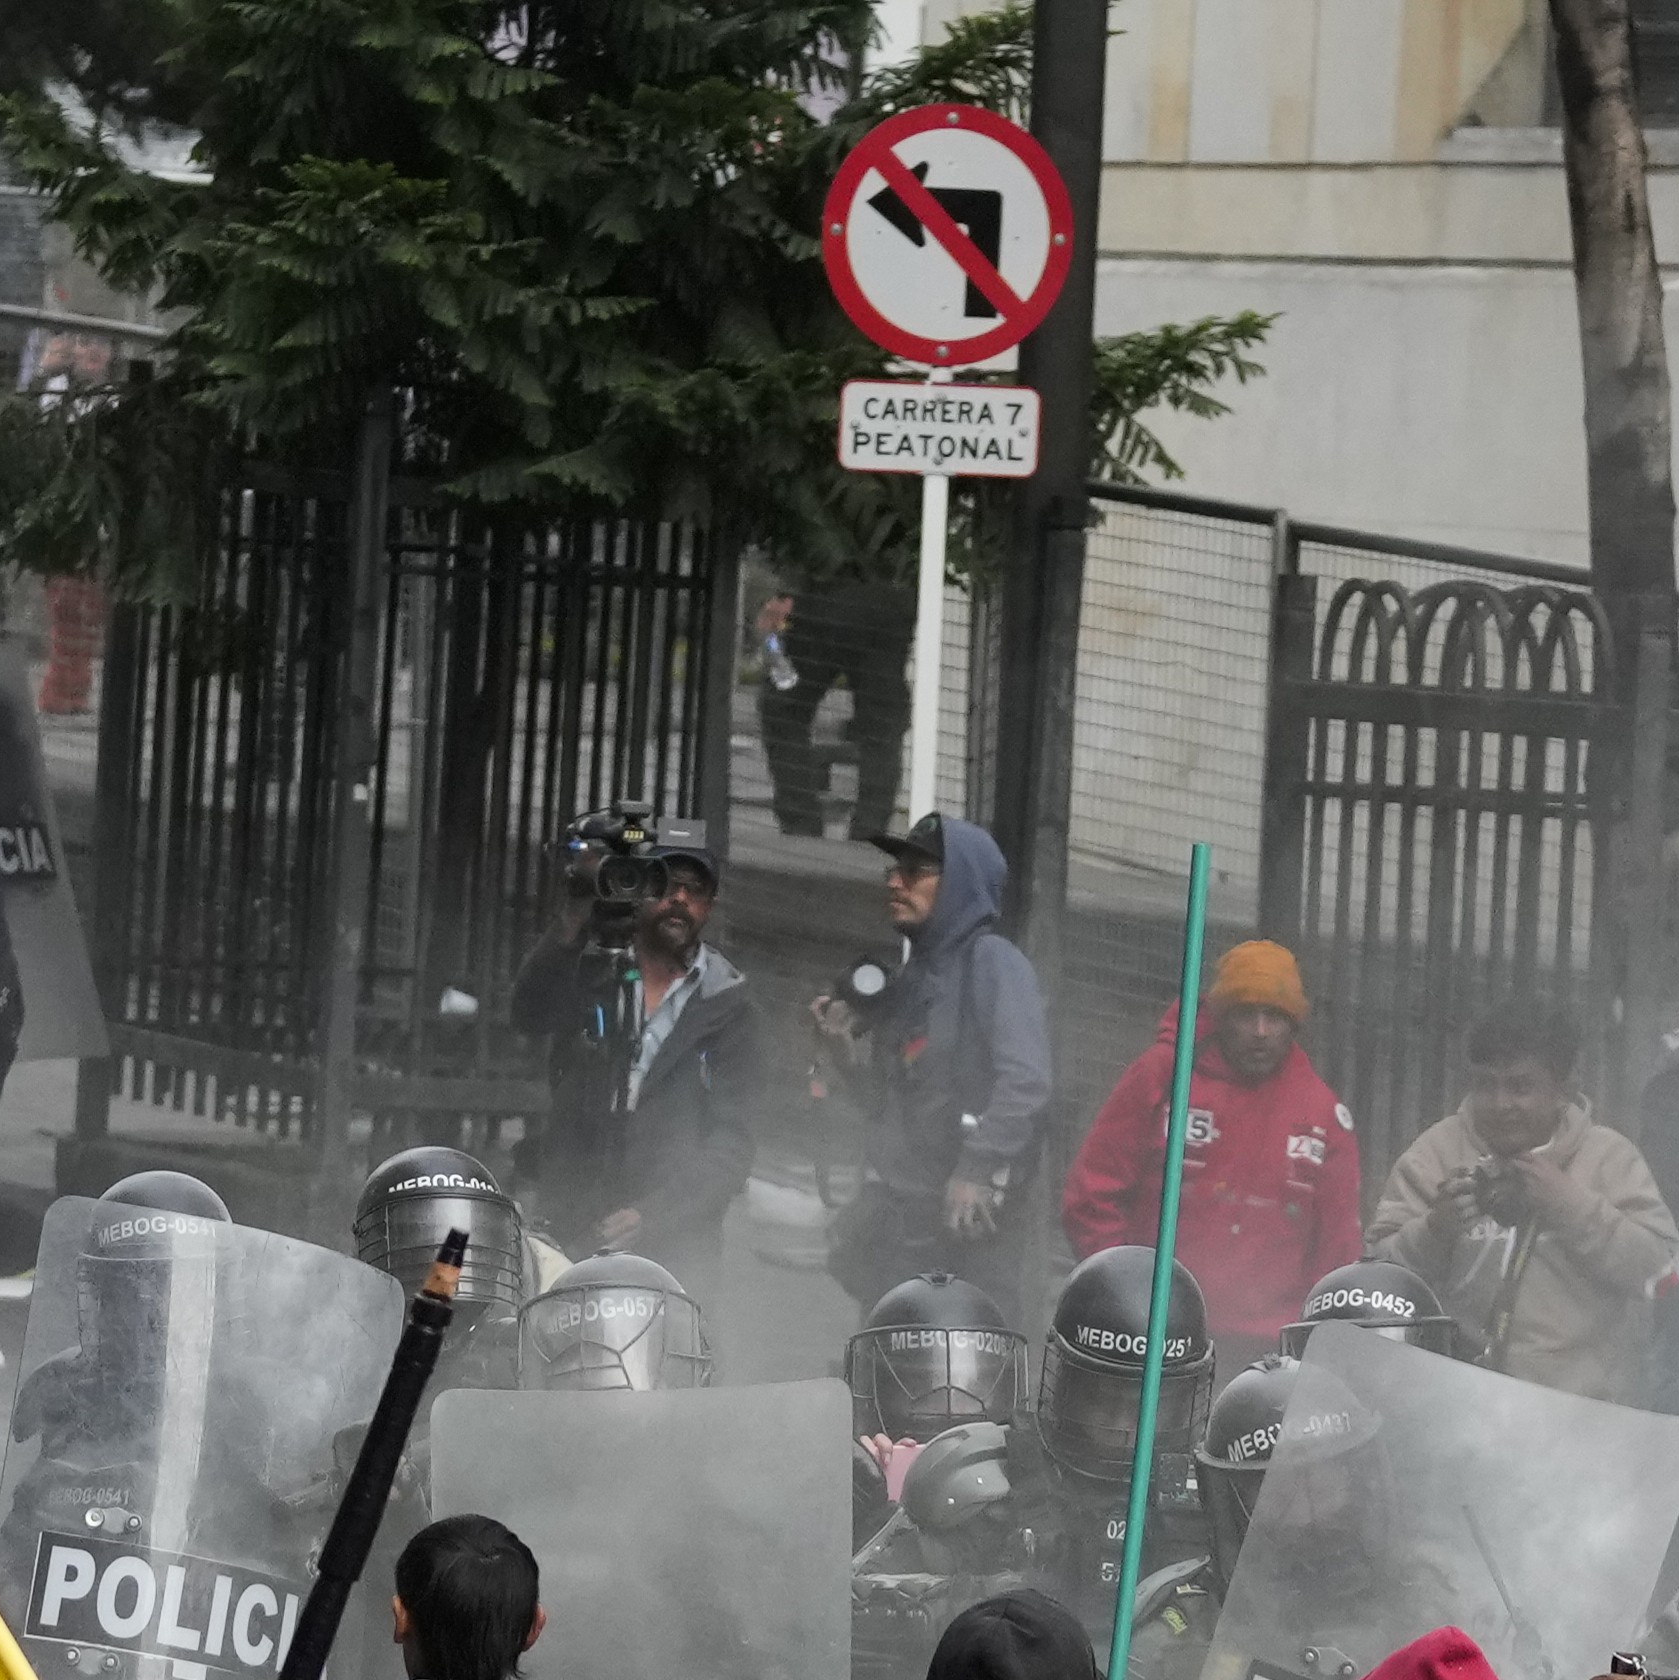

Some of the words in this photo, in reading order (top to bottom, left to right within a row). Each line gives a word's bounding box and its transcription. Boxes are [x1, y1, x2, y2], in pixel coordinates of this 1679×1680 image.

[862, 397, 997, 427] CARRERA
[1006, 402, 1023, 428] 7
[851, 430, 1025, 463] PEATONAL
[99, 1215, 221, 1246] MEBOG-0541
[1302, 1288, 1415, 1321] MEBOG-0452
